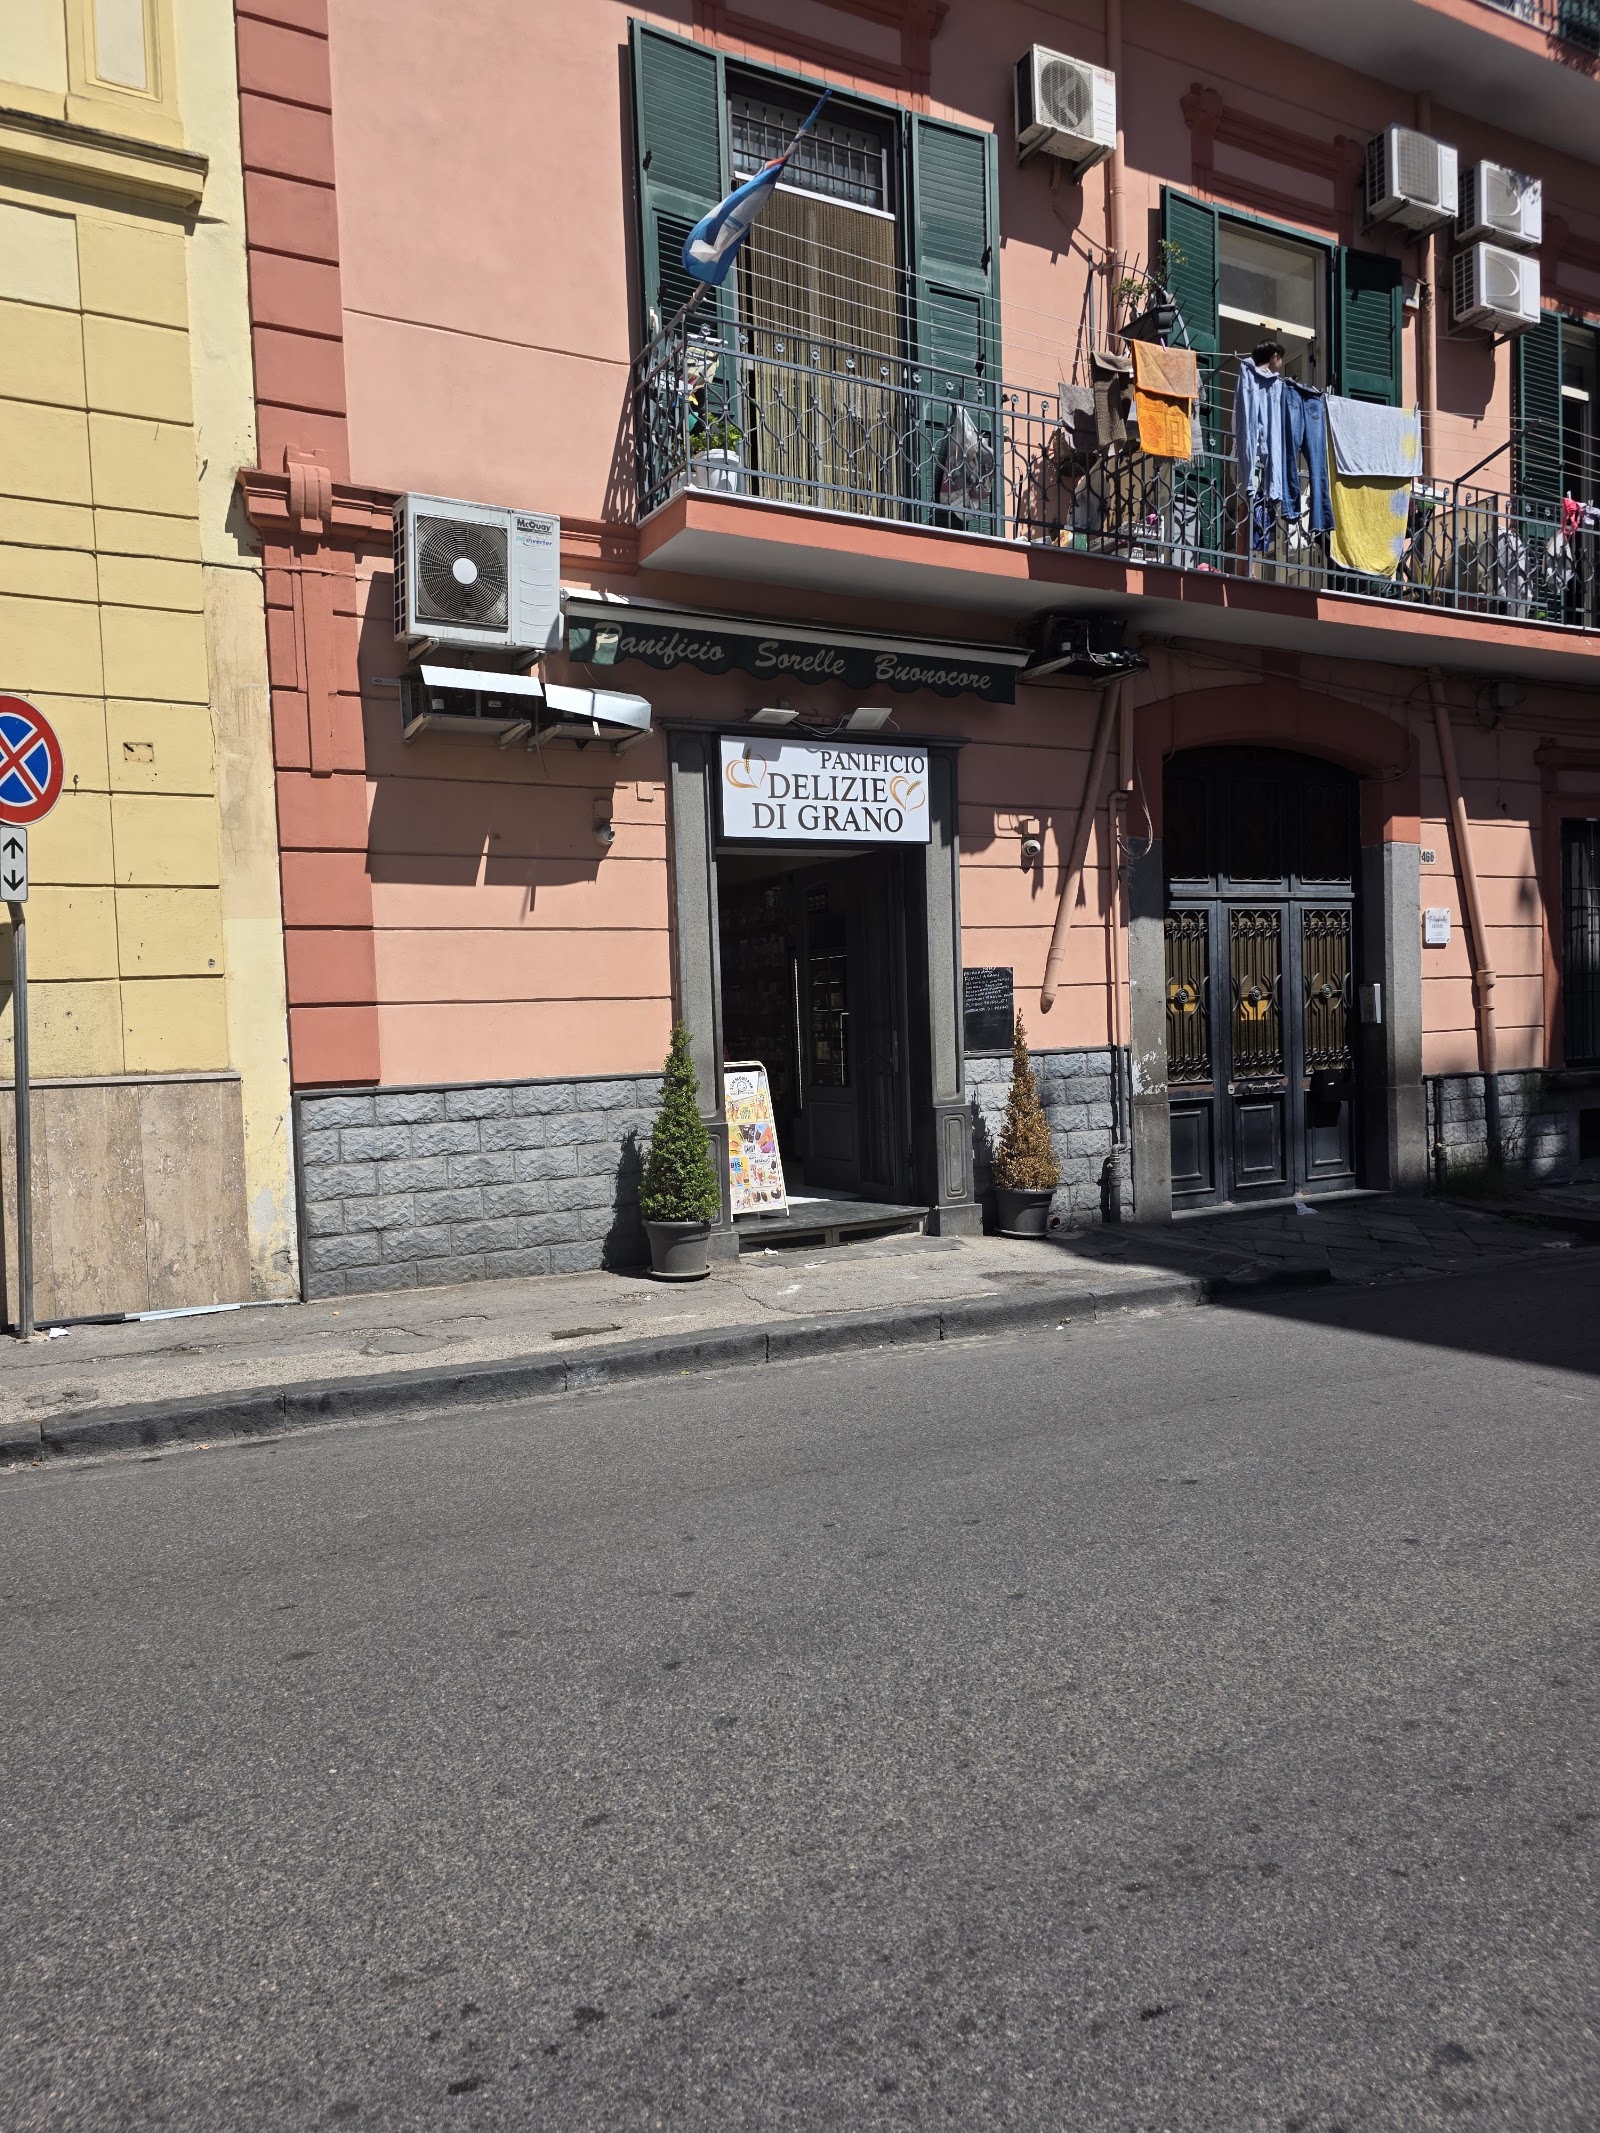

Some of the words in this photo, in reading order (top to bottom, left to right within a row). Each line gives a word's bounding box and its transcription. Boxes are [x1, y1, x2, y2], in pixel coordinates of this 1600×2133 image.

[517, 519, 551, 532] McQuay
[593, 622, 725, 665] Panificio
[754, 640, 846, 675] Sorelle
[874, 653, 992, 689] Buonocore
[819, 750, 925, 774] PANIFICIO
[767, 772, 889, 803] DELIZIE
[751, 802, 788, 830] DI
[797, 804, 904, 833] GRANO
